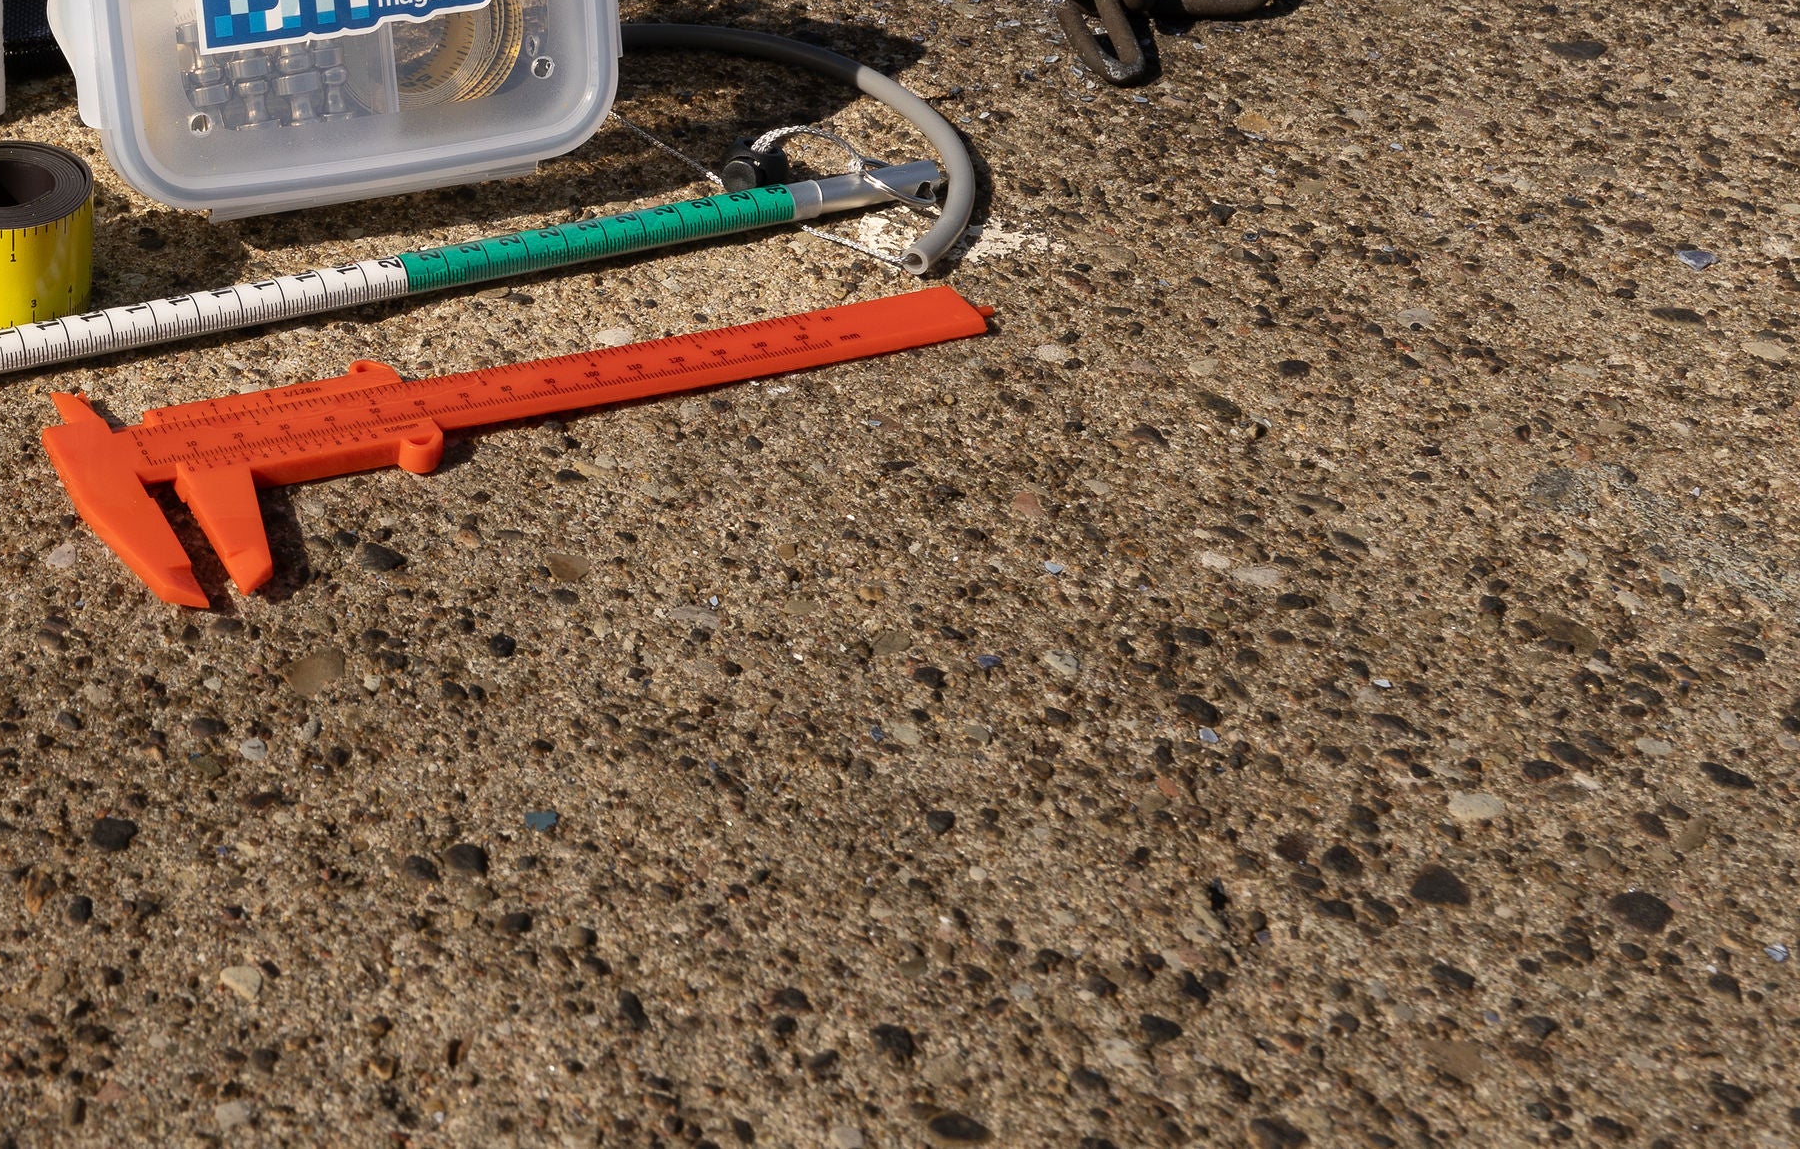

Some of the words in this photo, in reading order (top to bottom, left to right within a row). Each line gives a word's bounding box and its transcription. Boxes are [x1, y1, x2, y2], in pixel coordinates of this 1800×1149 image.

[10, 253, 17, 262] 1
[378, 255, 402, 269] 2
[30, 299, 38, 308] 3
[67, 285, 73, 294] 4
[839, 332, 861, 341] mm
